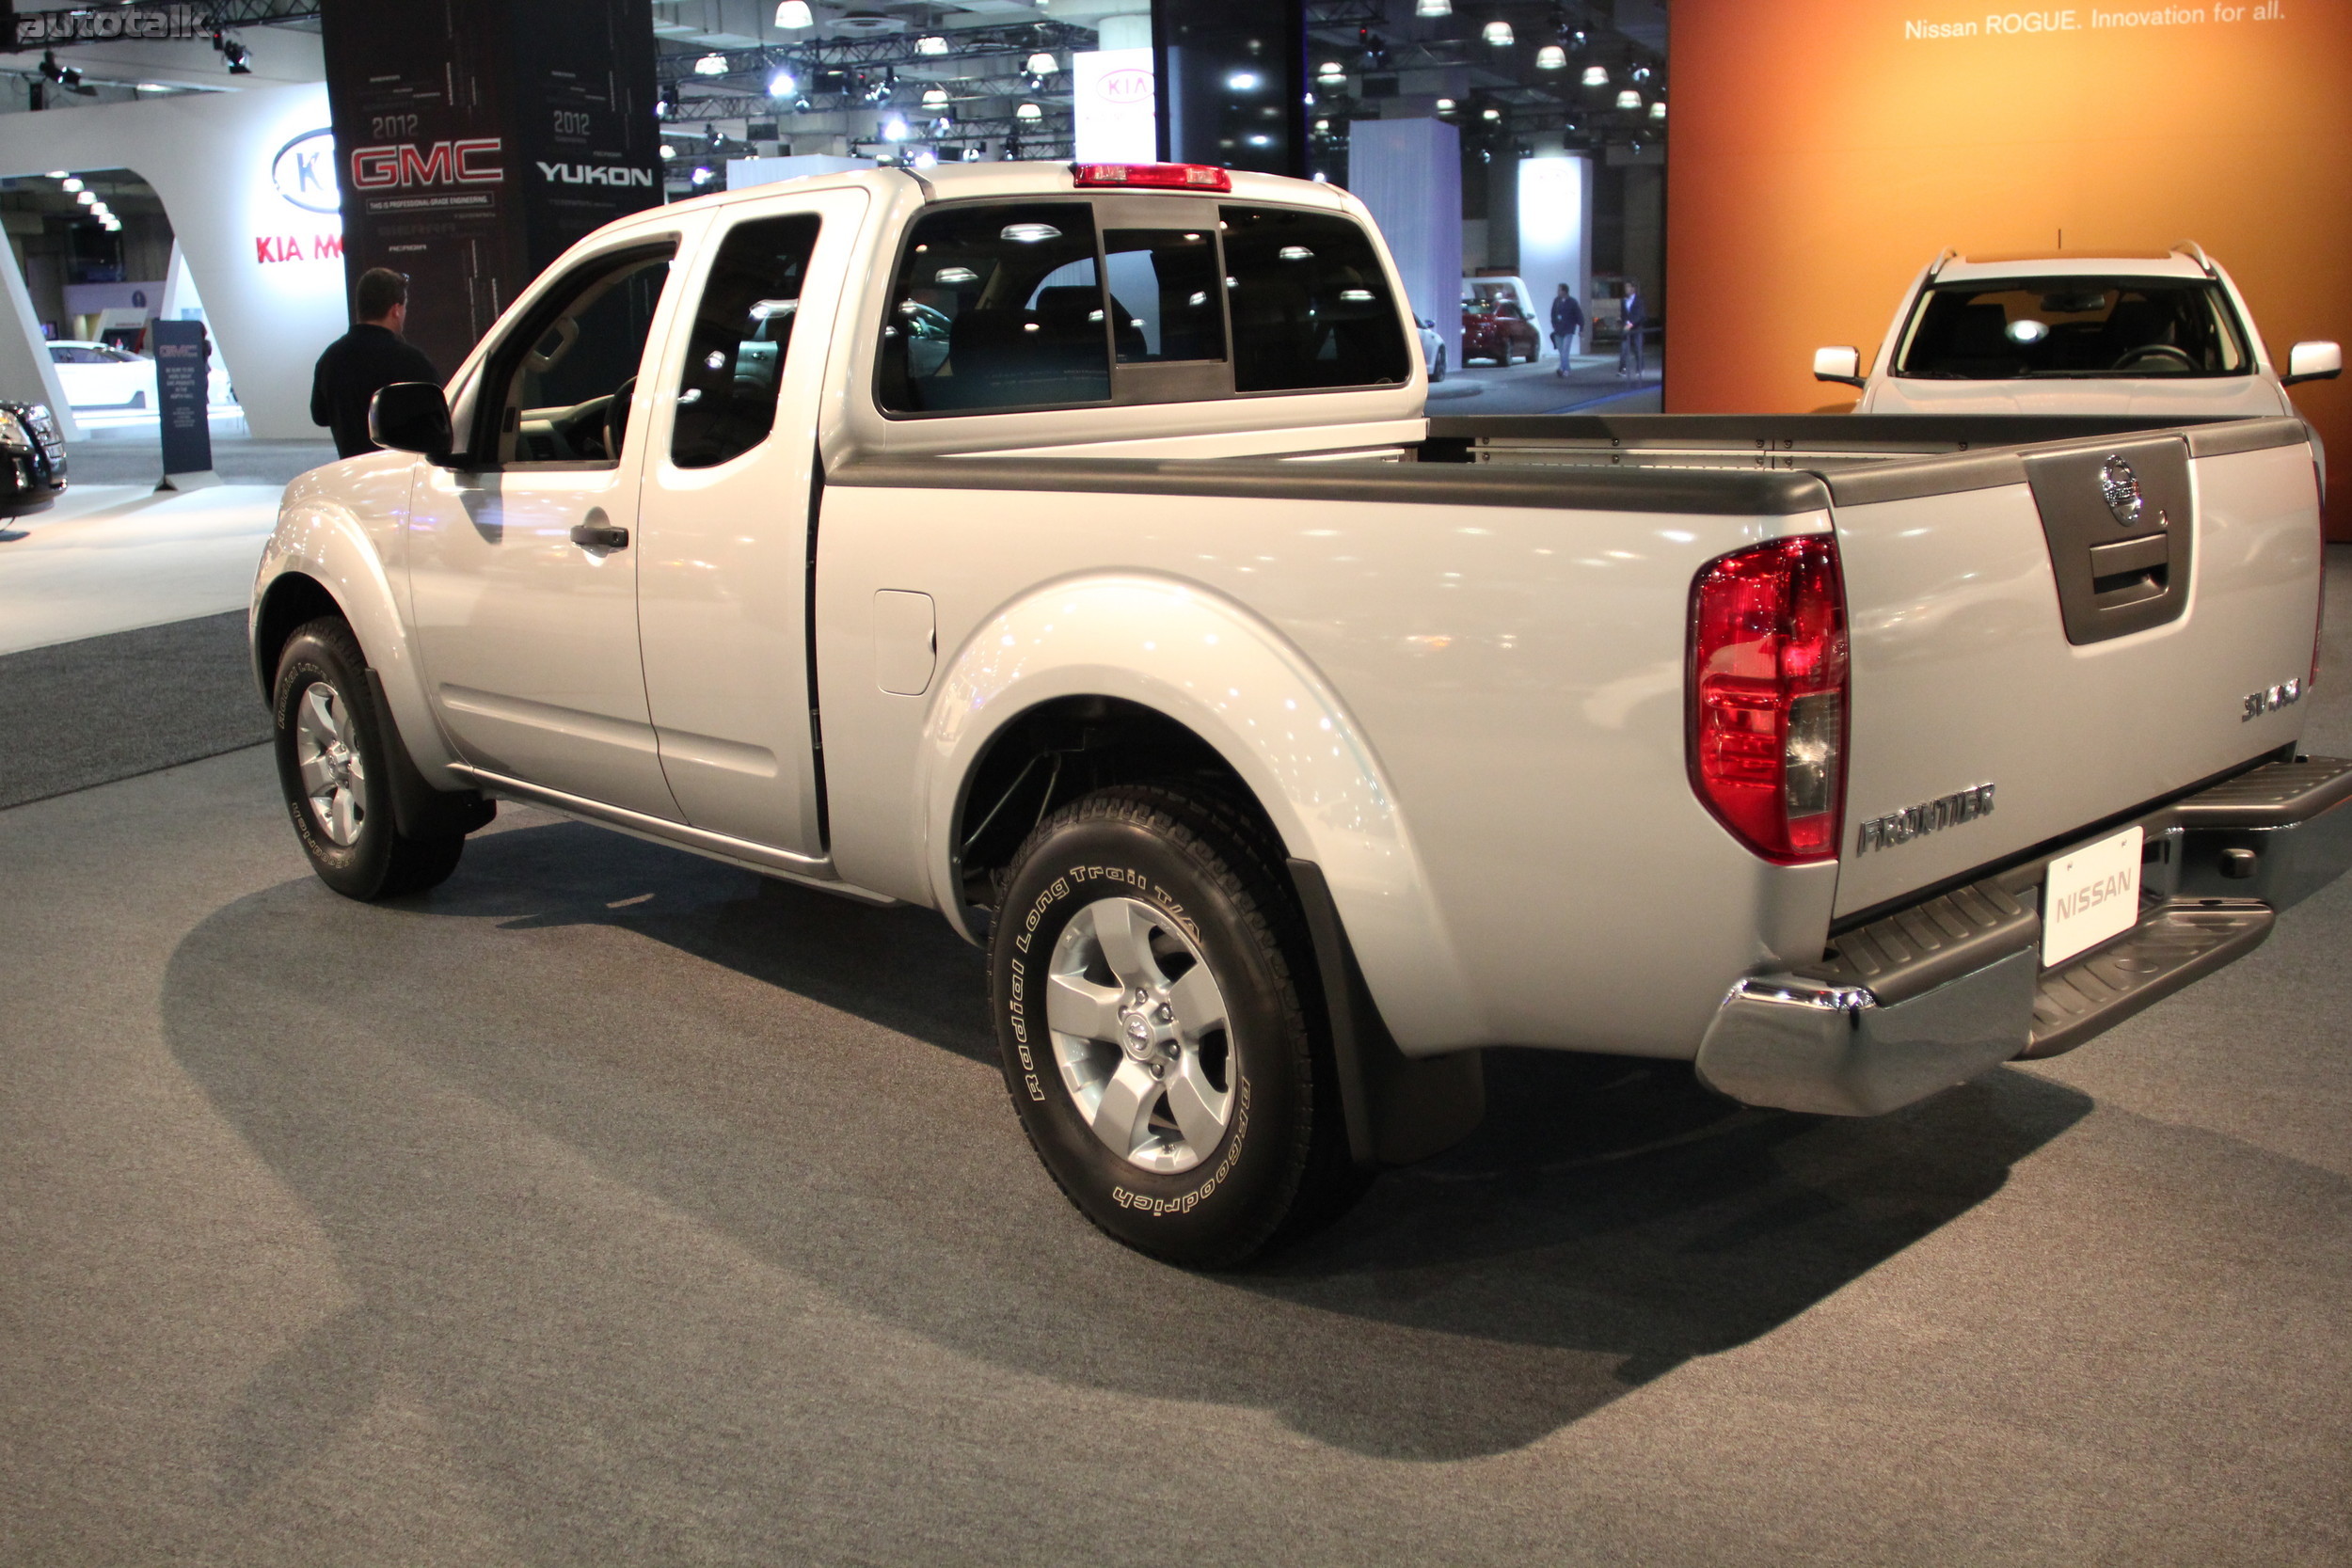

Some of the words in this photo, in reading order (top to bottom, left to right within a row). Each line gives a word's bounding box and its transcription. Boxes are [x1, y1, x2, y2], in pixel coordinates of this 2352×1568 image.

[1904, 20, 1978, 40] Nissan
[1985, 10, 2082, 35] ROGUE.
[2091, 6, 2205, 28] Innovation
[2213, 2, 2245, 23] for
[2252, 0, 2286, 21] all.
[1108, 77, 1148, 95] KIA
[372, 114, 420, 138] 2012
[553, 110, 591, 135] 2012
[351, 138, 504, 190] GMC
[536, 161, 653, 186] YUKON
[256, 236, 304, 264] KIA
[313, 233, 344, 261] M
[1856, 782, 1995, 858] FRONTIER
[1070, 865, 1148, 891] Trail
[2057, 867, 2132, 924] NISSAN
[1016, 877, 1071, 954] Long
[1010, 958, 1046, 1102] Radial
[1112, 1075, 1251, 1217] BFGoodrich
